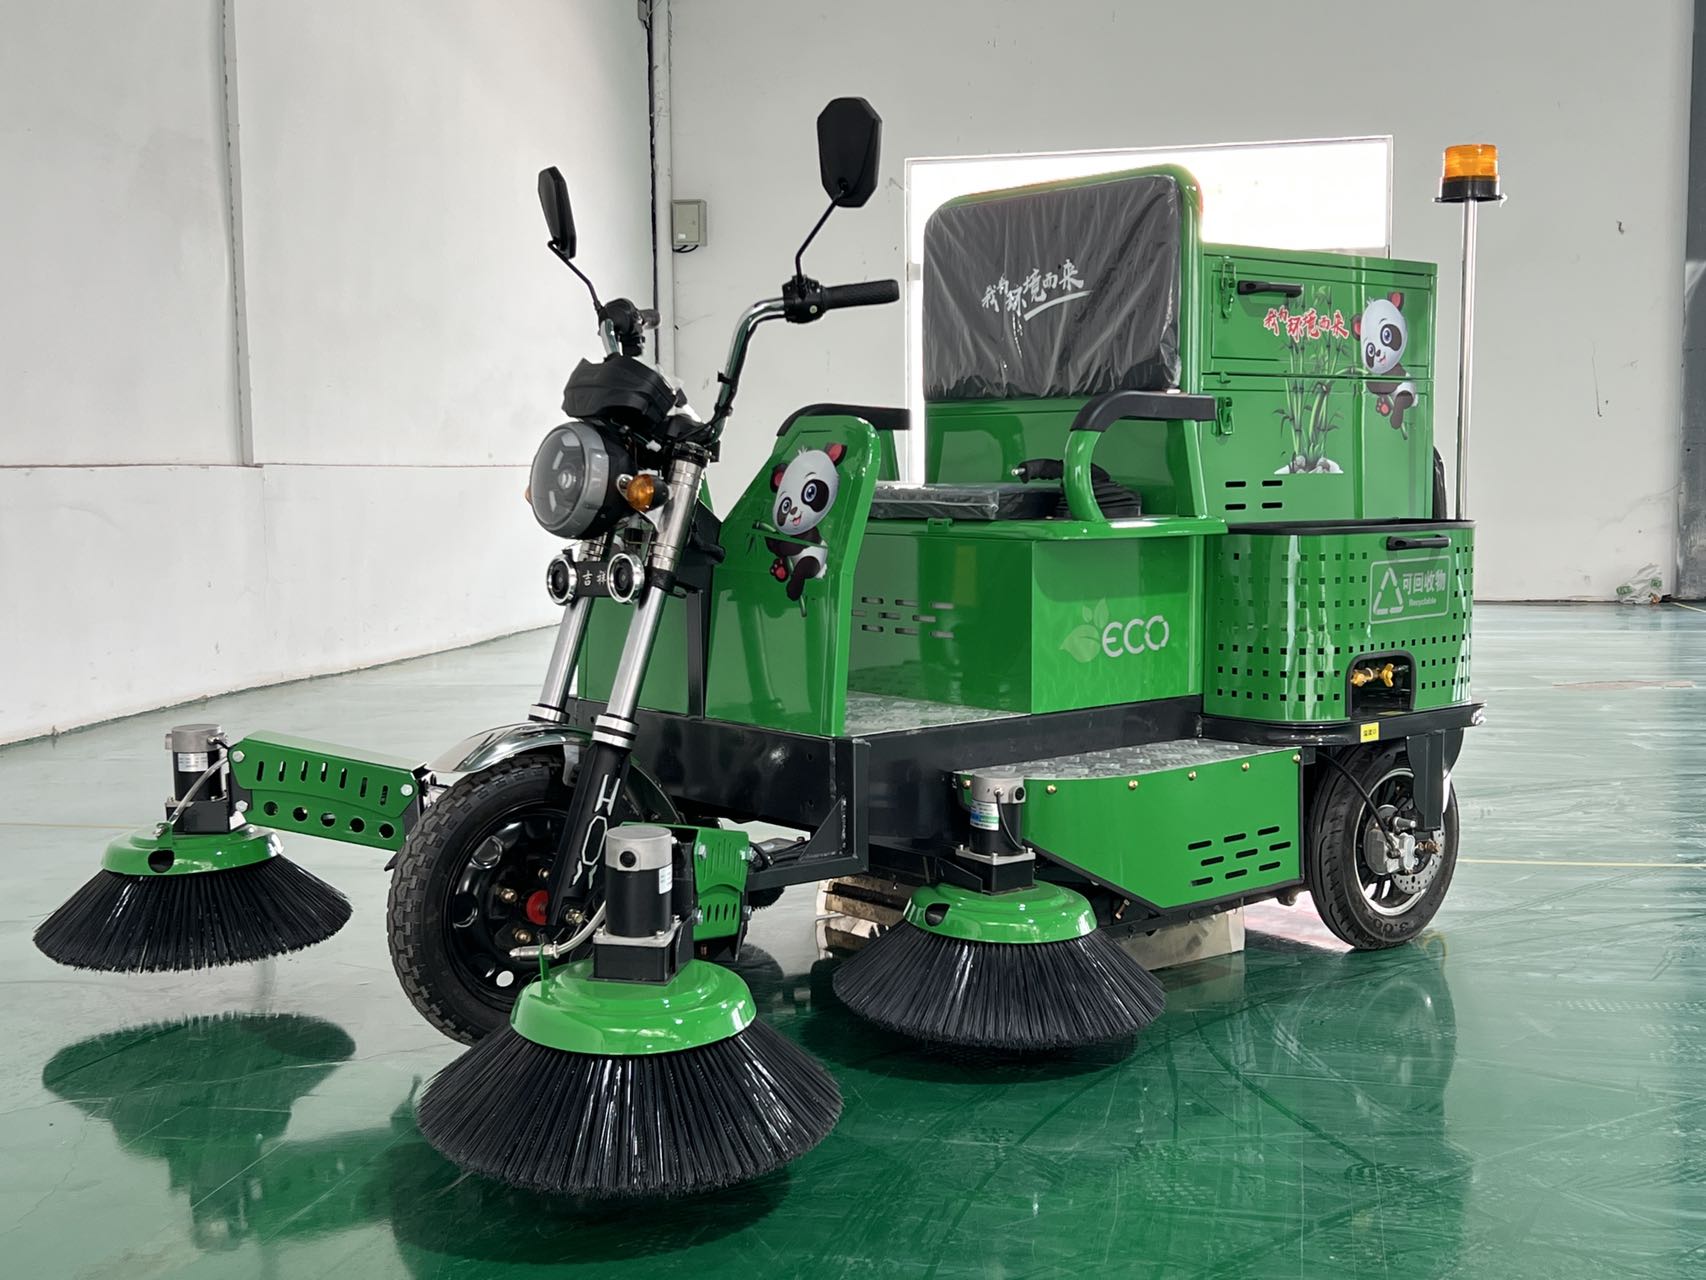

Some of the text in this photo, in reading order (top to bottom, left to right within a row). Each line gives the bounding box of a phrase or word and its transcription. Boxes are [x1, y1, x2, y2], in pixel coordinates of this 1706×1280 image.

[982, 259, 1084, 316] 我为环境而来
[1263, 305, 1349, 343] 我为环境而来
[1403, 569, 1446, 595] 可回收物
[1102, 615, 1169, 657] ECO
